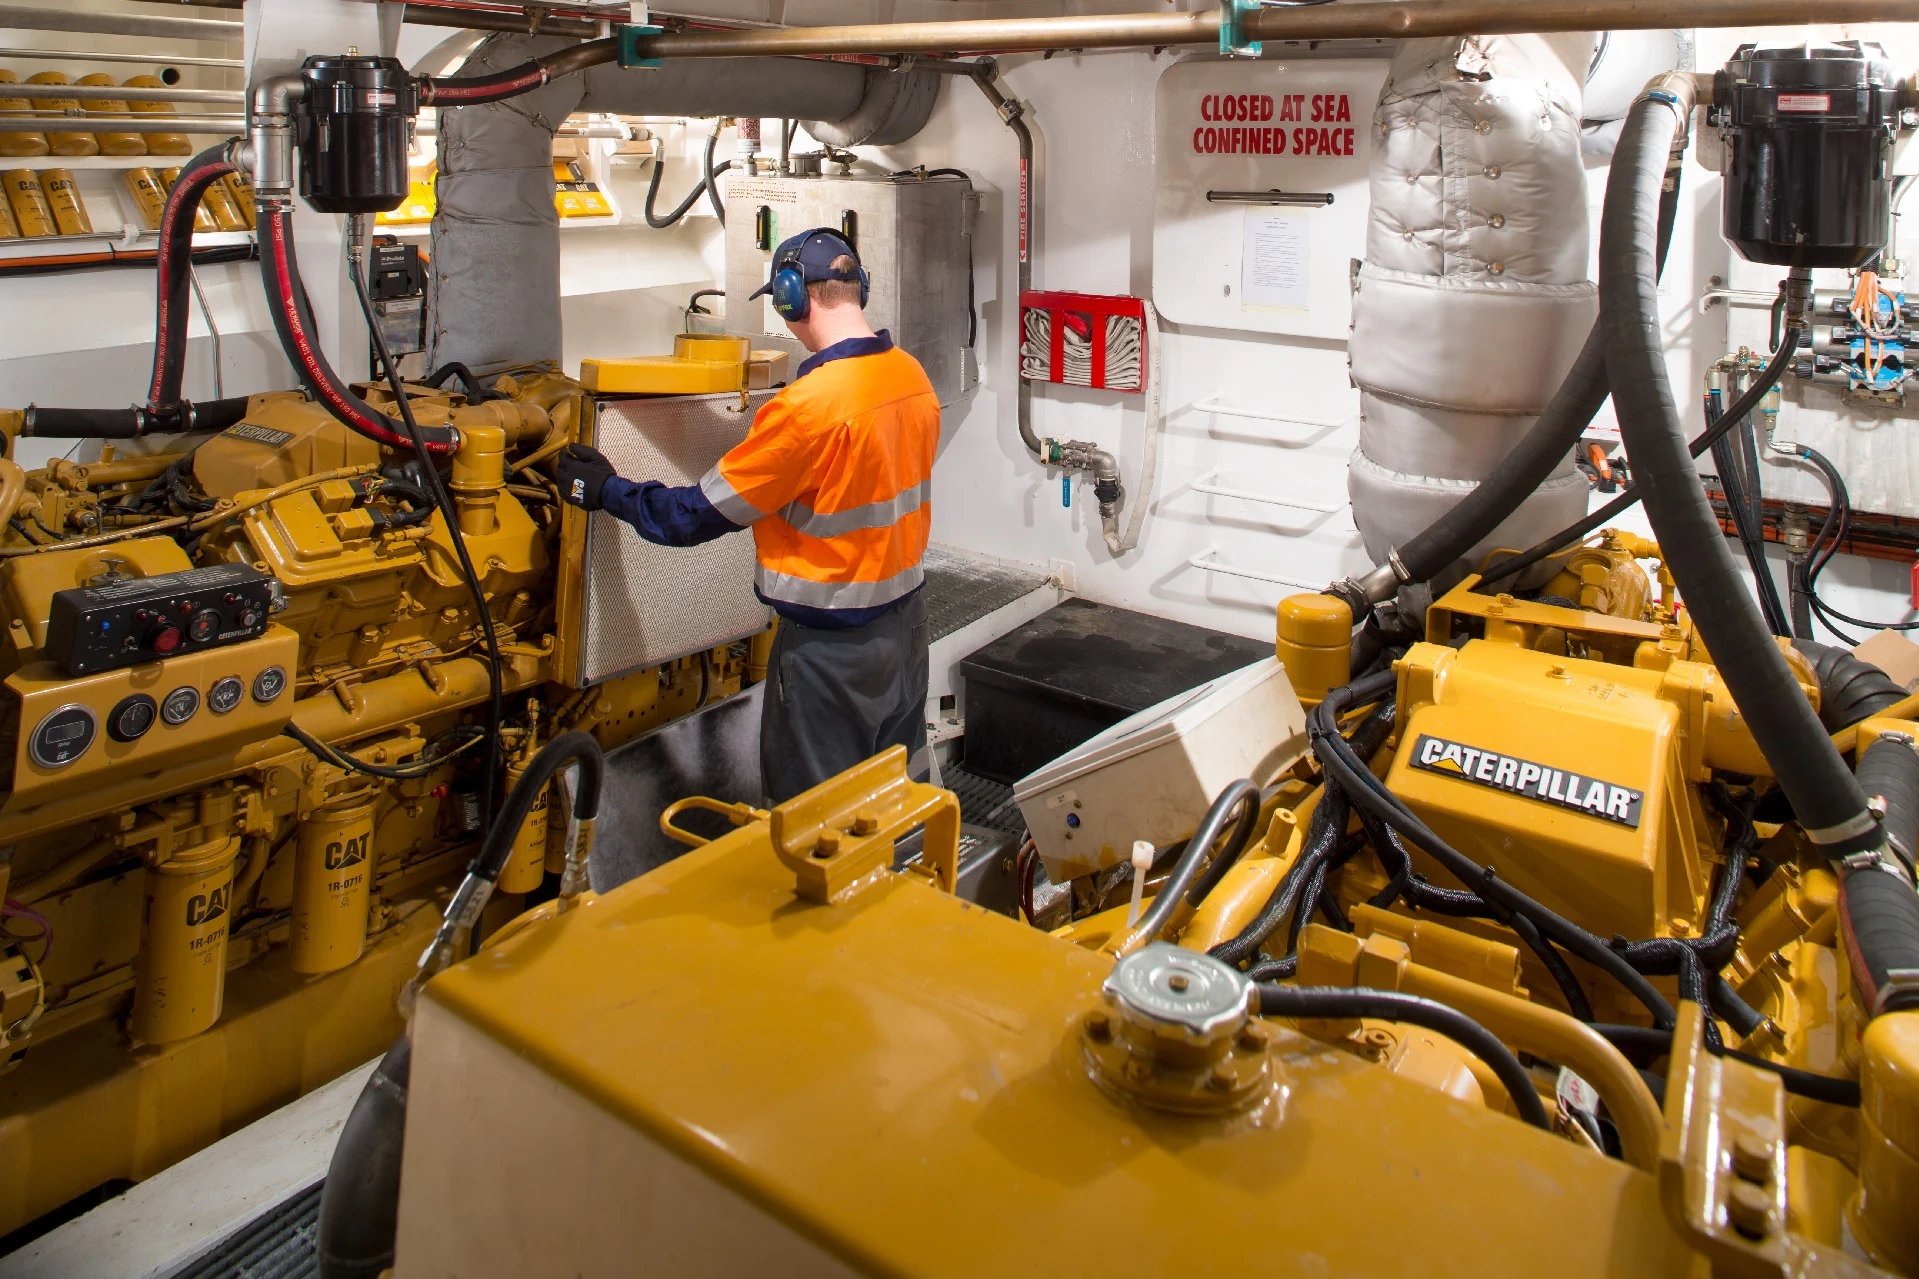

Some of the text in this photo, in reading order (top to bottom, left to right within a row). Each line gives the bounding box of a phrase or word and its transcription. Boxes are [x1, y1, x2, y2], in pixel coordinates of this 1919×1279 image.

[1200, 94, 1351, 123] CLOSED AT SEA
[1193, 127, 1354, 156] CONFINED SPACE
[50, 180, 74, 192] CAT
[275, 228, 283, 241] PSI
[306, 356, 315, 370] OIL
[312, 368, 334, 397] DELIVERY
[571, 478, 585, 500] CAT
[218, 628, 254, 640] CATERPILLAR
[1420, 738, 1638, 820] CATERPILLAR
[324, 831, 371, 870] CAT
[328, 874, 363, 892] 1R-0716
[186, 879, 233, 927] CAT
[190, 926, 226, 950] 1R-0716
